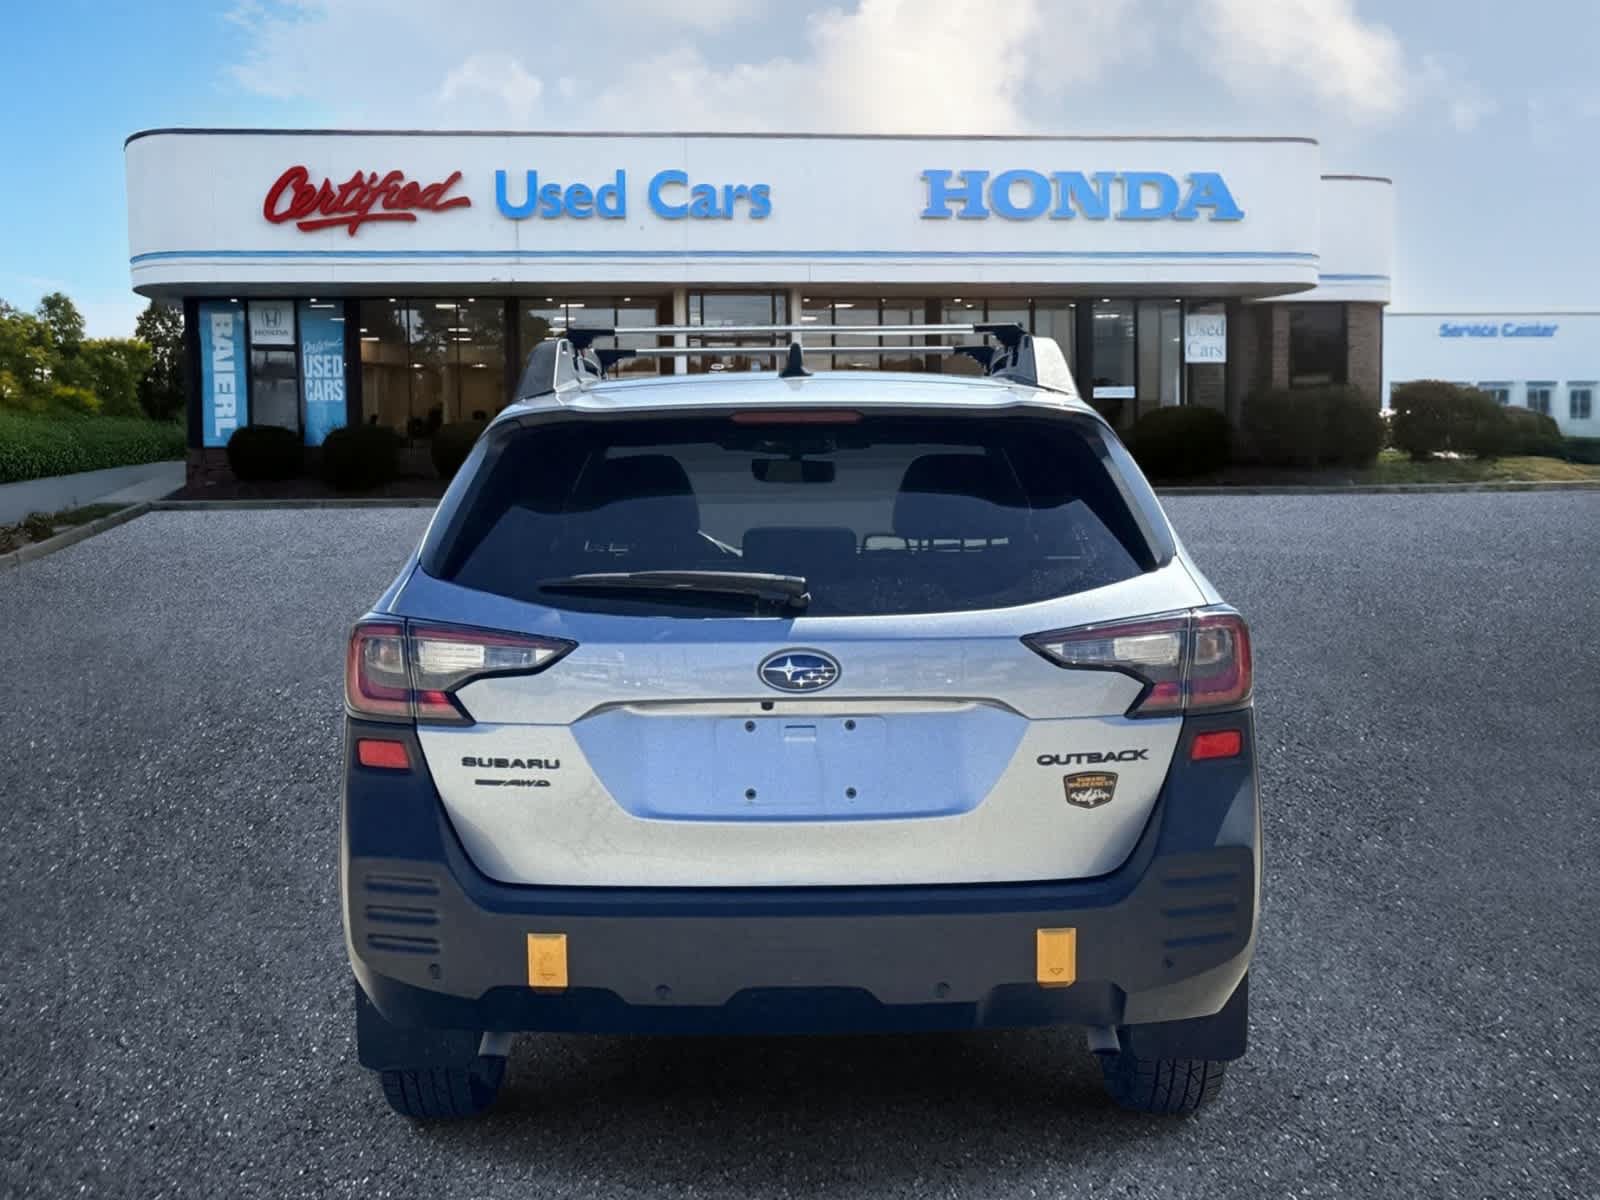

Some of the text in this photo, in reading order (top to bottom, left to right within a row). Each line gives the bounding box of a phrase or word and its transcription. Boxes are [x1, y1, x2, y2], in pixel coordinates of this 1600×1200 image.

[264, 165, 772, 236] Certified Used Cars
[920, 169, 1245, 221] HONDA
[254, 329, 289, 337] HONDA
[1186, 319, 1225, 336] Used
[1439, 322, 1559, 337] Service Center
[1187, 341, 1224, 357] Cars
[303, 354, 343, 378] USED
[211, 313, 236, 437] BAIERL
[304, 379, 344, 402] CARS
[461, 756, 561, 770] SUBARU
[1036, 748, 1149, 766] OUTBACK
[503, 778, 551, 788] AWD
